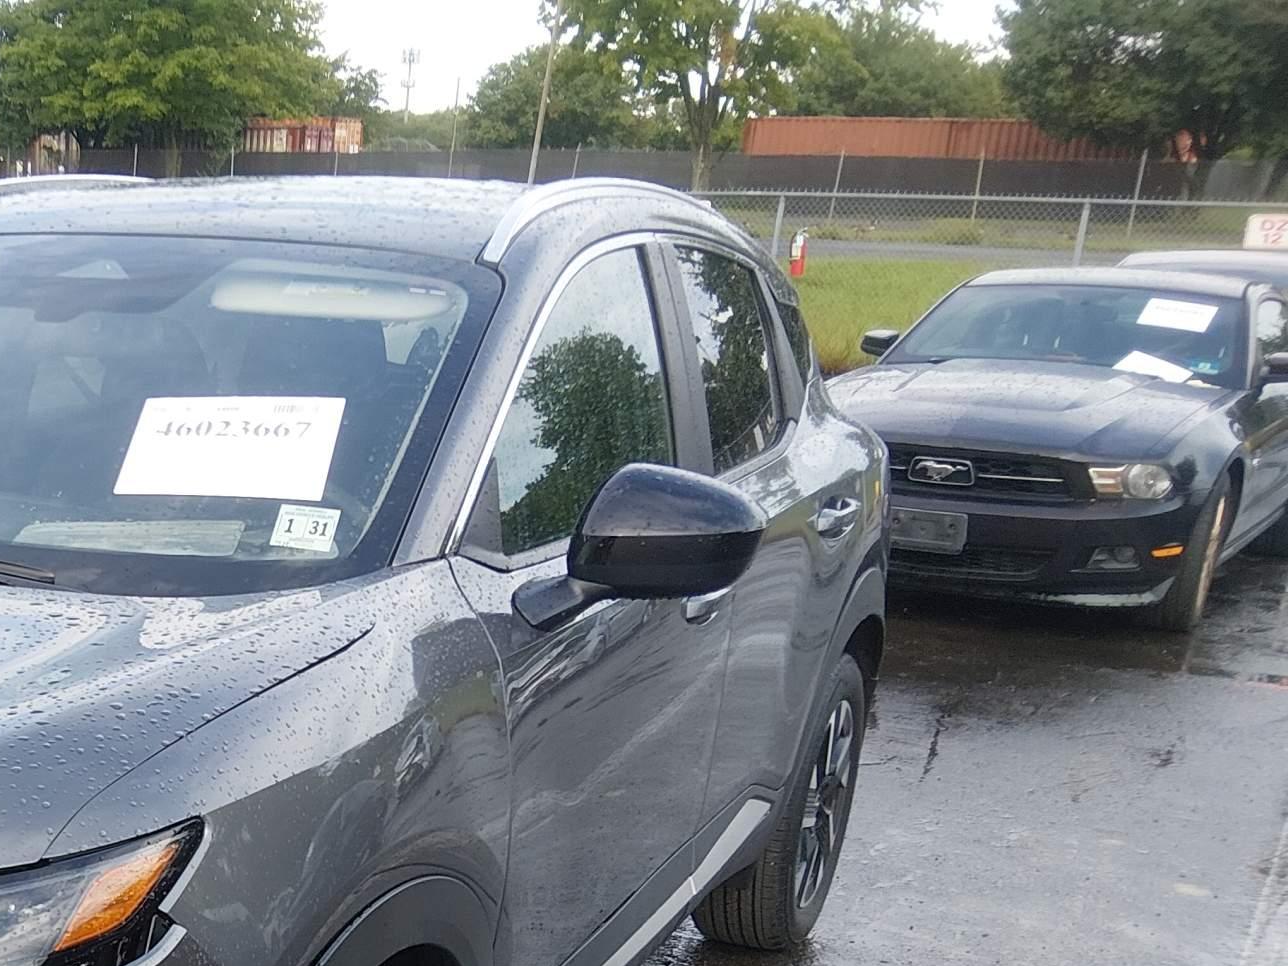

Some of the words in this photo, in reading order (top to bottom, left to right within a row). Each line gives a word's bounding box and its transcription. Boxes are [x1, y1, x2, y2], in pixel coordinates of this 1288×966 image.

[156, 420, 312, 438] 46023667
[284, 518, 295, 534] 1
[308, 520, 329, 537] 31
